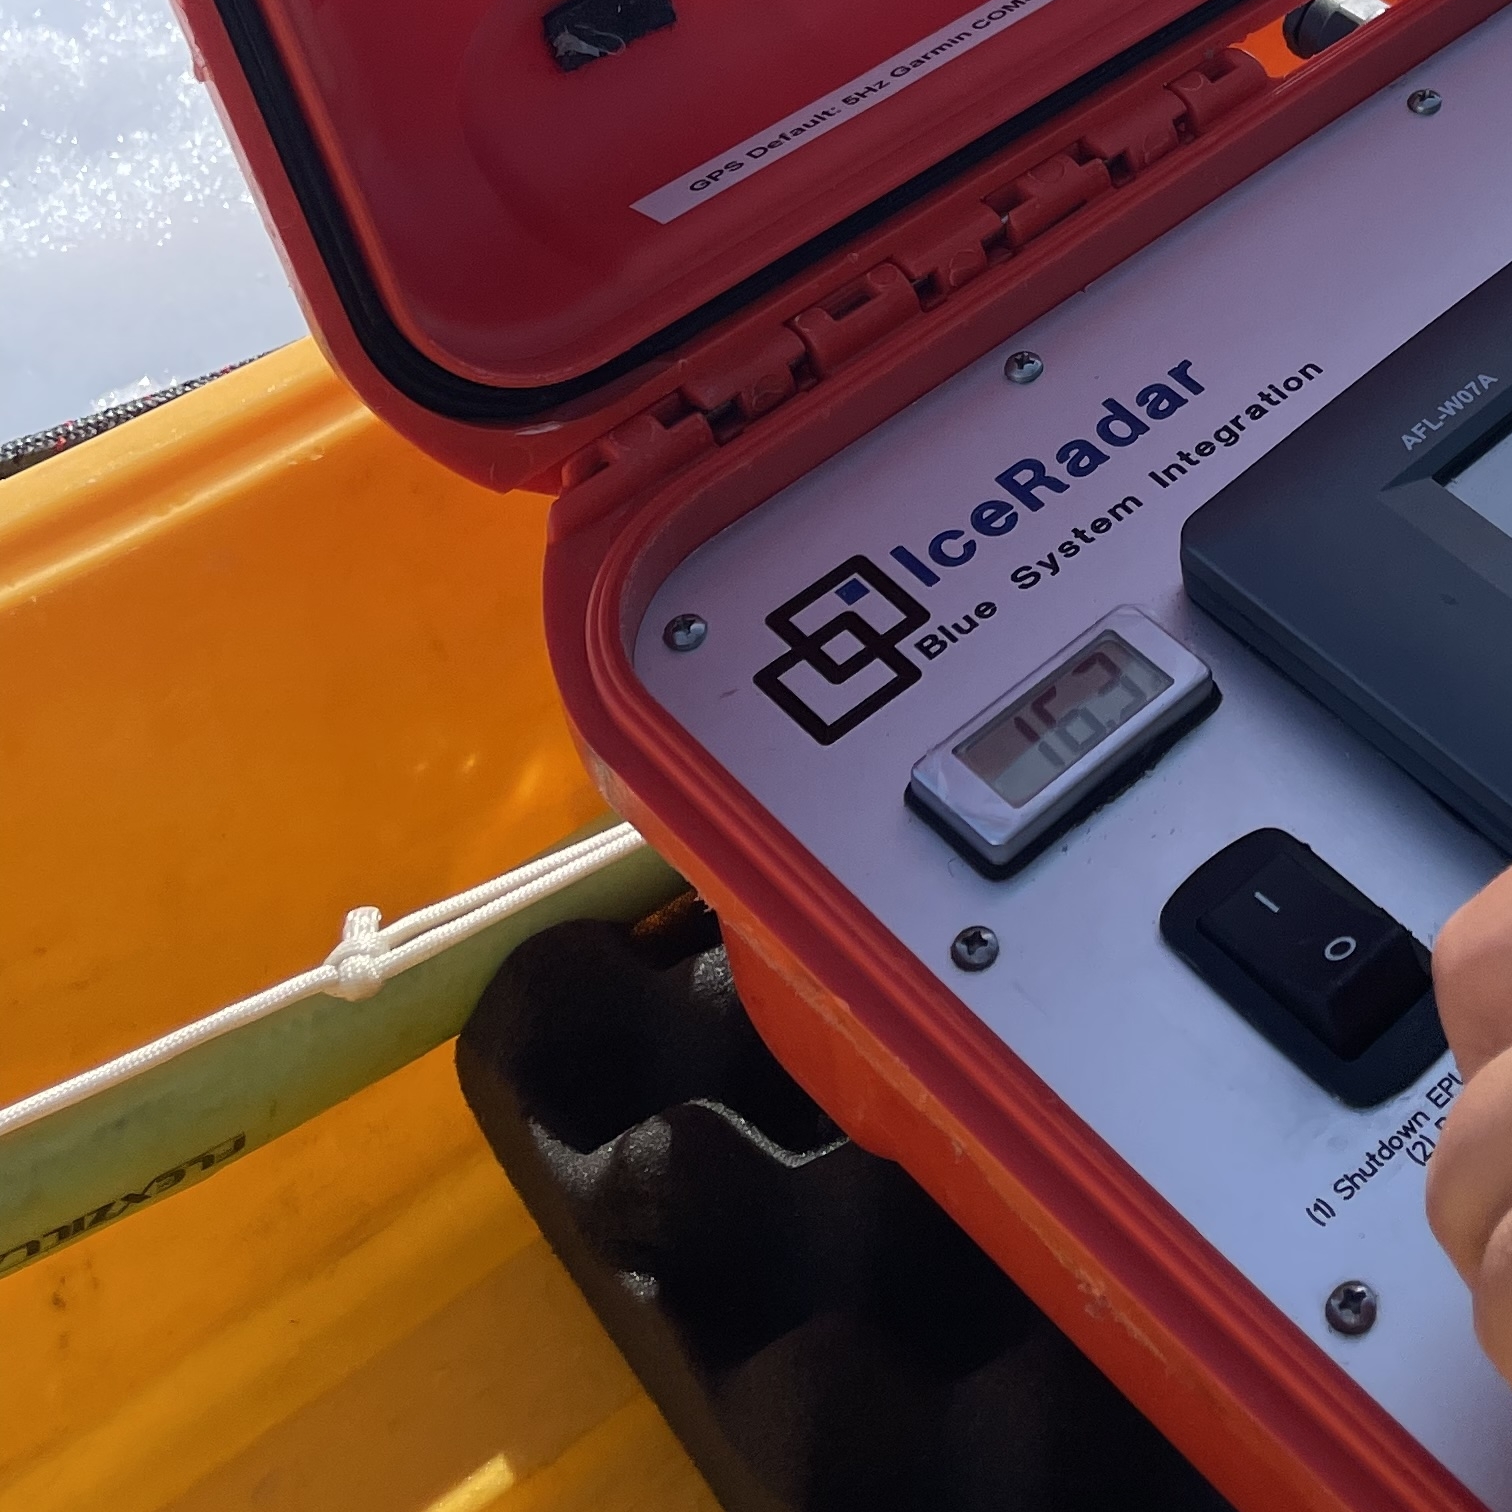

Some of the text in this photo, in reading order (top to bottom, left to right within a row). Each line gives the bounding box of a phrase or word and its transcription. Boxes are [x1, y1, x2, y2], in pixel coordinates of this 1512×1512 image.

[688, 159, 745, 194] GPS
[745, 104, 842, 161] Default:
[841, 76, 891, 108] 5Hz
[889, 29, 972, 79] Garmin
[889, 354, 1208, 590] IceRadar
[1401, 374, 1499, 451] AFL-W07A
[912, 358, 1327, 664] Blue System Integration
[1306, 1110, 1431, 1227] (1) Shutdown
